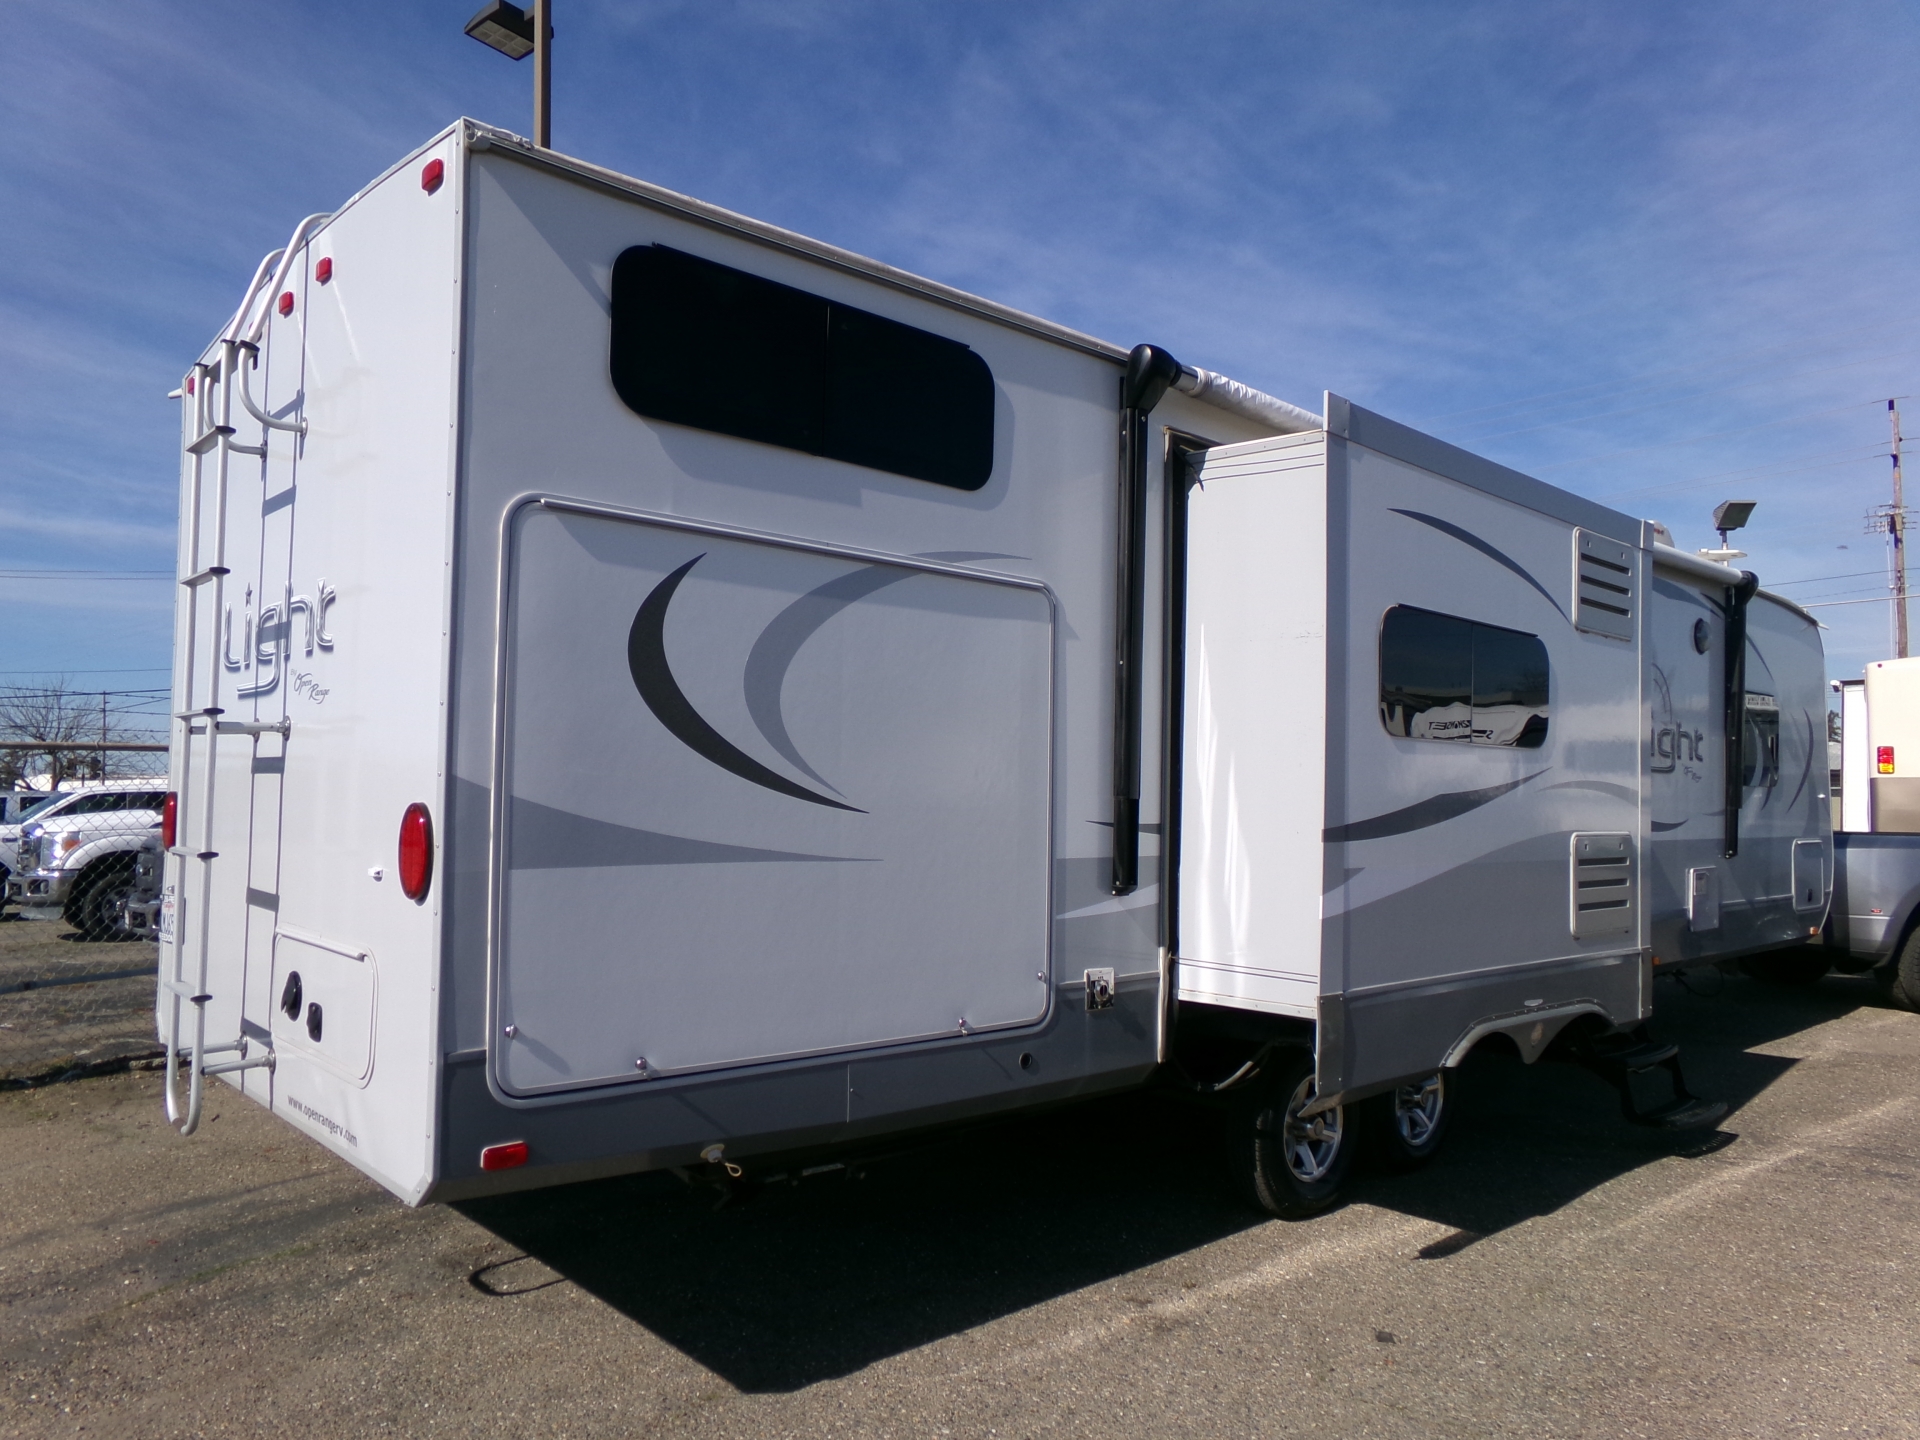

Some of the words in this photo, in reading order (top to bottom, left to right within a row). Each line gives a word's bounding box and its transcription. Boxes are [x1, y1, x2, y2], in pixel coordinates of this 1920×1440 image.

[294, 672, 313, 696] Open
[307, 683, 331, 705] Range
[1651, 711, 1704, 774] ight
[287, 1095, 358, 1148] www.openrangerv.com
